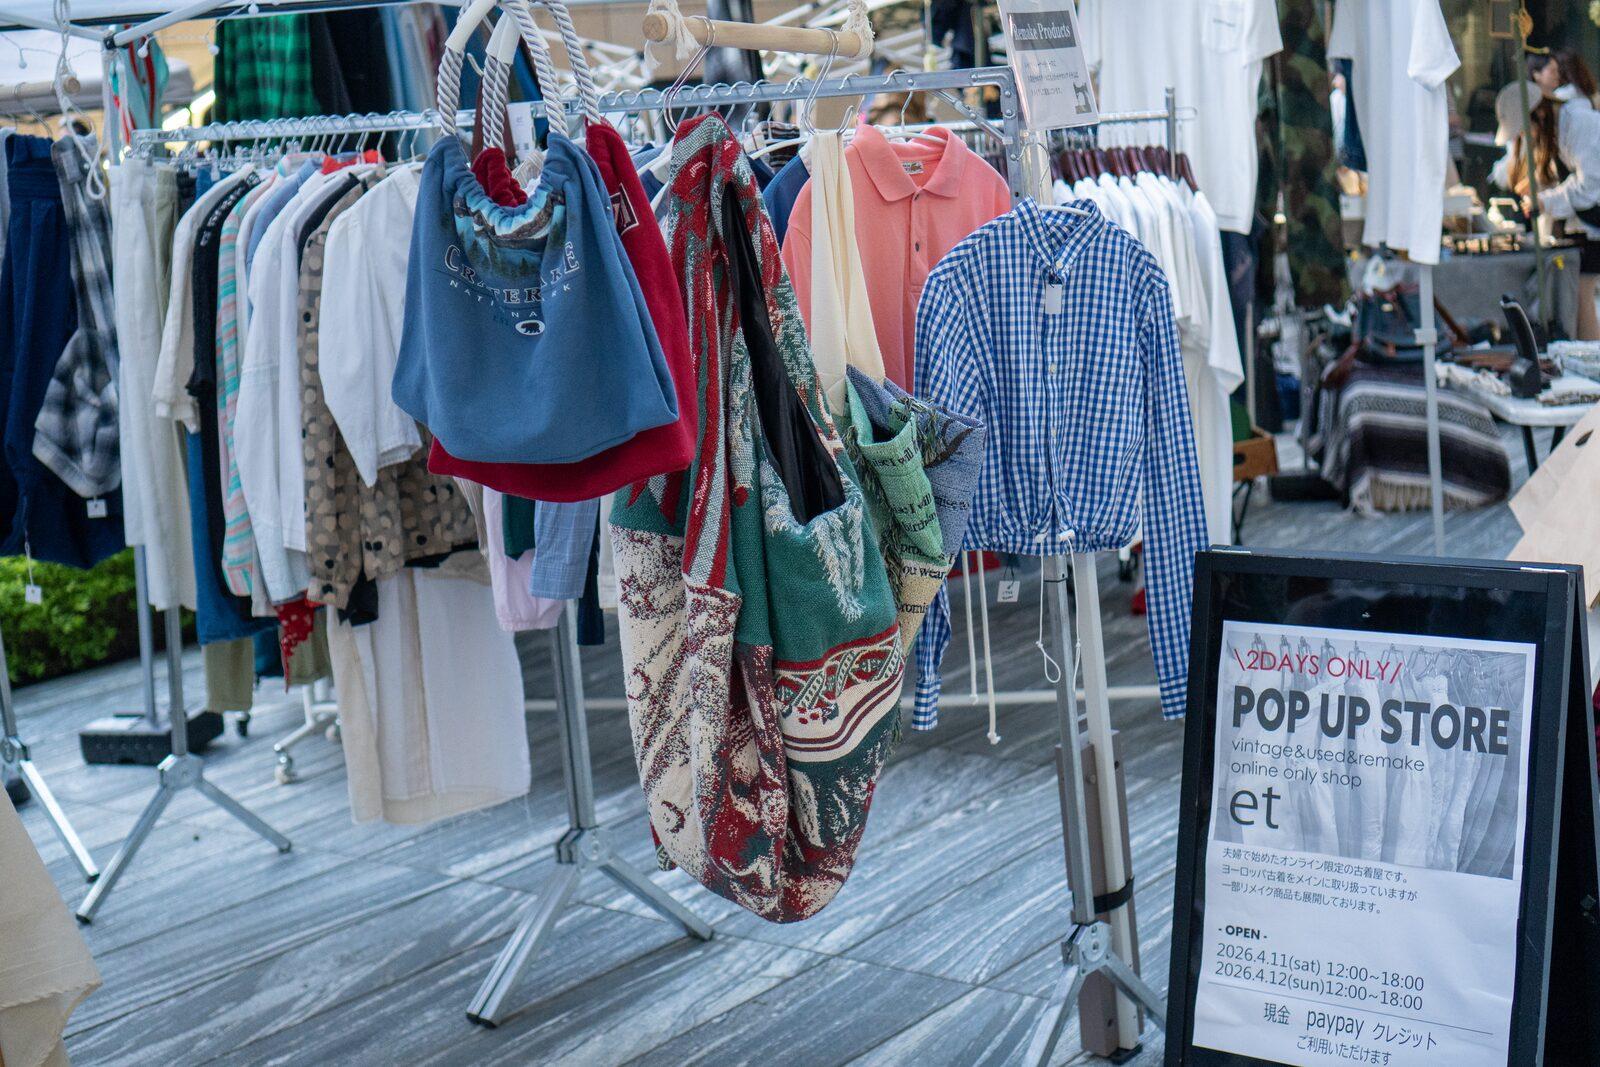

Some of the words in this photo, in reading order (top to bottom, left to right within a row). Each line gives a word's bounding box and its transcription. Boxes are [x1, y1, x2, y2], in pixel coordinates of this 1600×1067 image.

[1037, 21, 1071, 40] Products
[1232, 685, 1310, 733] POP
[1320, 692, 1371, 740] UP
[1380, 698, 1511, 756] STORE
[1231, 738, 1425, 773] vintage&used&remake
[1231, 761, 1279, 779] online
[1283, 766, 1318, 785] only
[1321, 770, 1362, 790] shop
[1229, 786, 1282, 830] et
[1221, 864, 1418, 902] ヨーロッパ古着をメインに取り扱っていますが
[1222, 847, 1408, 884] 夫婦で始めたオンライン限定の古着屋です。
[1221, 881, 1381, 915] 一部リメイク商品も展開しております。
[1216, 942, 1321, 977] 2026.4.11(sat)
[1263, 1002, 1291, 1026] 現金
[1306, 1009, 1365, 1040] paypay
[1372, 1022, 1438, 1051] クレジット
[1296, 1034, 1392, 1067] ご利用いただけます
